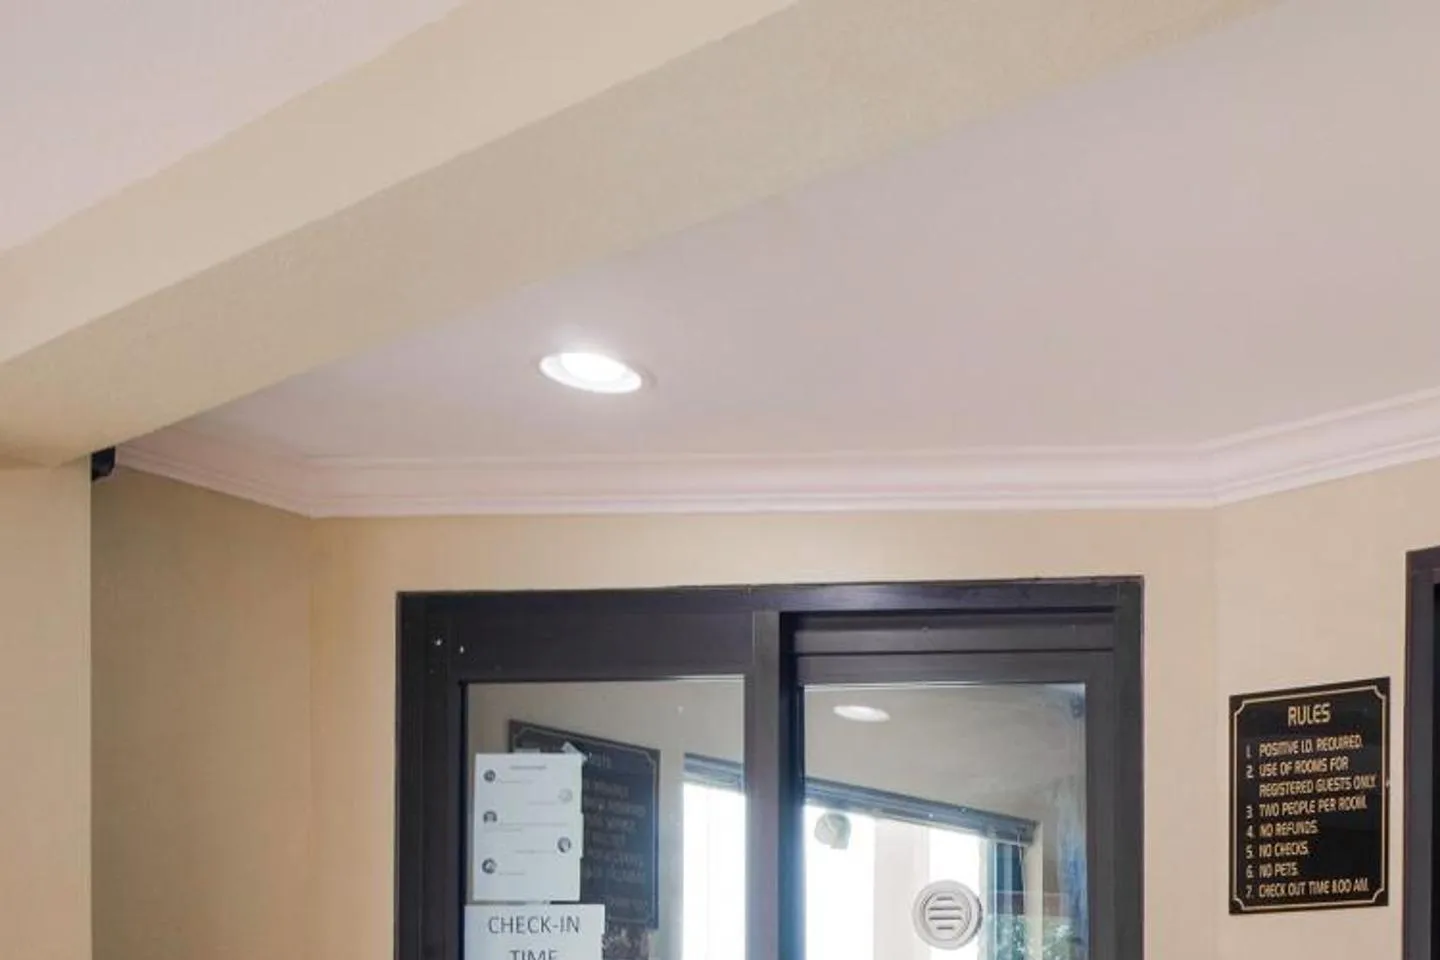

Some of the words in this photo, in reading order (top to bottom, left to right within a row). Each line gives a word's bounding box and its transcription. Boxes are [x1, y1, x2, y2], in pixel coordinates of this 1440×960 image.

[1287, 702, 1332, 727] RULES
[1259, 740, 1299, 757] POSITIVE
[1259, 762, 1278, 777] USE
[1280, 761, 1293, 776] OF
[1294, 757, 1328, 774] ROOMS
[1330, 755, 1349, 772] FOR
[1259, 778, 1314, 797] REGISTERED
[1315, 775, 1352, 793] GUESTS
[1259, 802, 1280, 817] TWO
[1281, 799, 1316, 816] PEOPLE
[1318, 797, 1337, 813] PER
[1259, 822, 1273, 837] NO
[1259, 843, 1272, 858] NO
[1259, 863, 1273, 878] NO
[1259, 882, 1286, 898] CHECK
[1287, 881, 1307, 897] OUT
[1309, 880, 1331, 896] TIME
[488, 915, 580, 934] CHECK-IN
